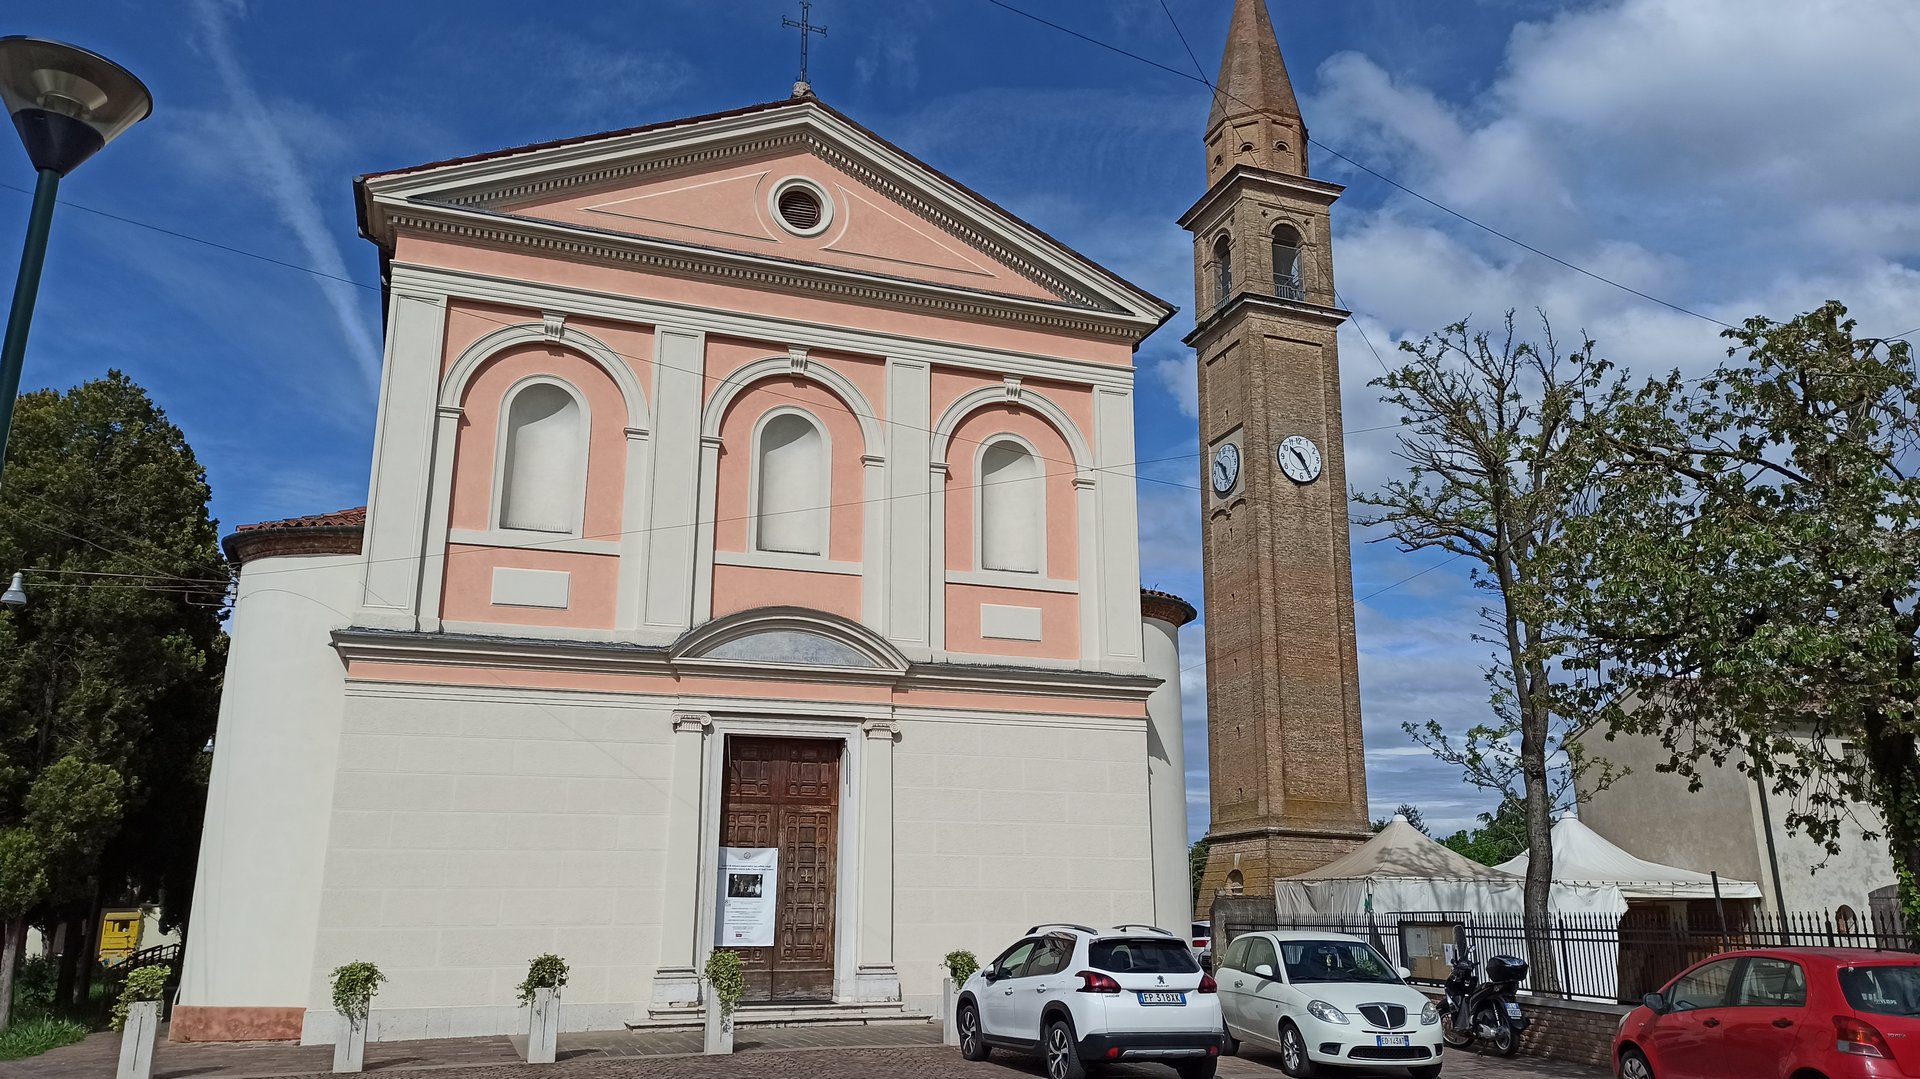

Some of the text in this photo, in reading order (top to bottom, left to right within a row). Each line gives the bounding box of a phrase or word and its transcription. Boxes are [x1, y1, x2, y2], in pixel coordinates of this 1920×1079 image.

[1282, 444, 1289, 452] 10
[1311, 447, 1316, 455] 2
[1280, 452, 1285, 460] 9
[1315, 456, 1320, 464] 3
[1284, 462, 1289, 470] 8
[1299, 472, 1304, 480] 6
[1143, 993, 1180, 1002] FP 318XK
